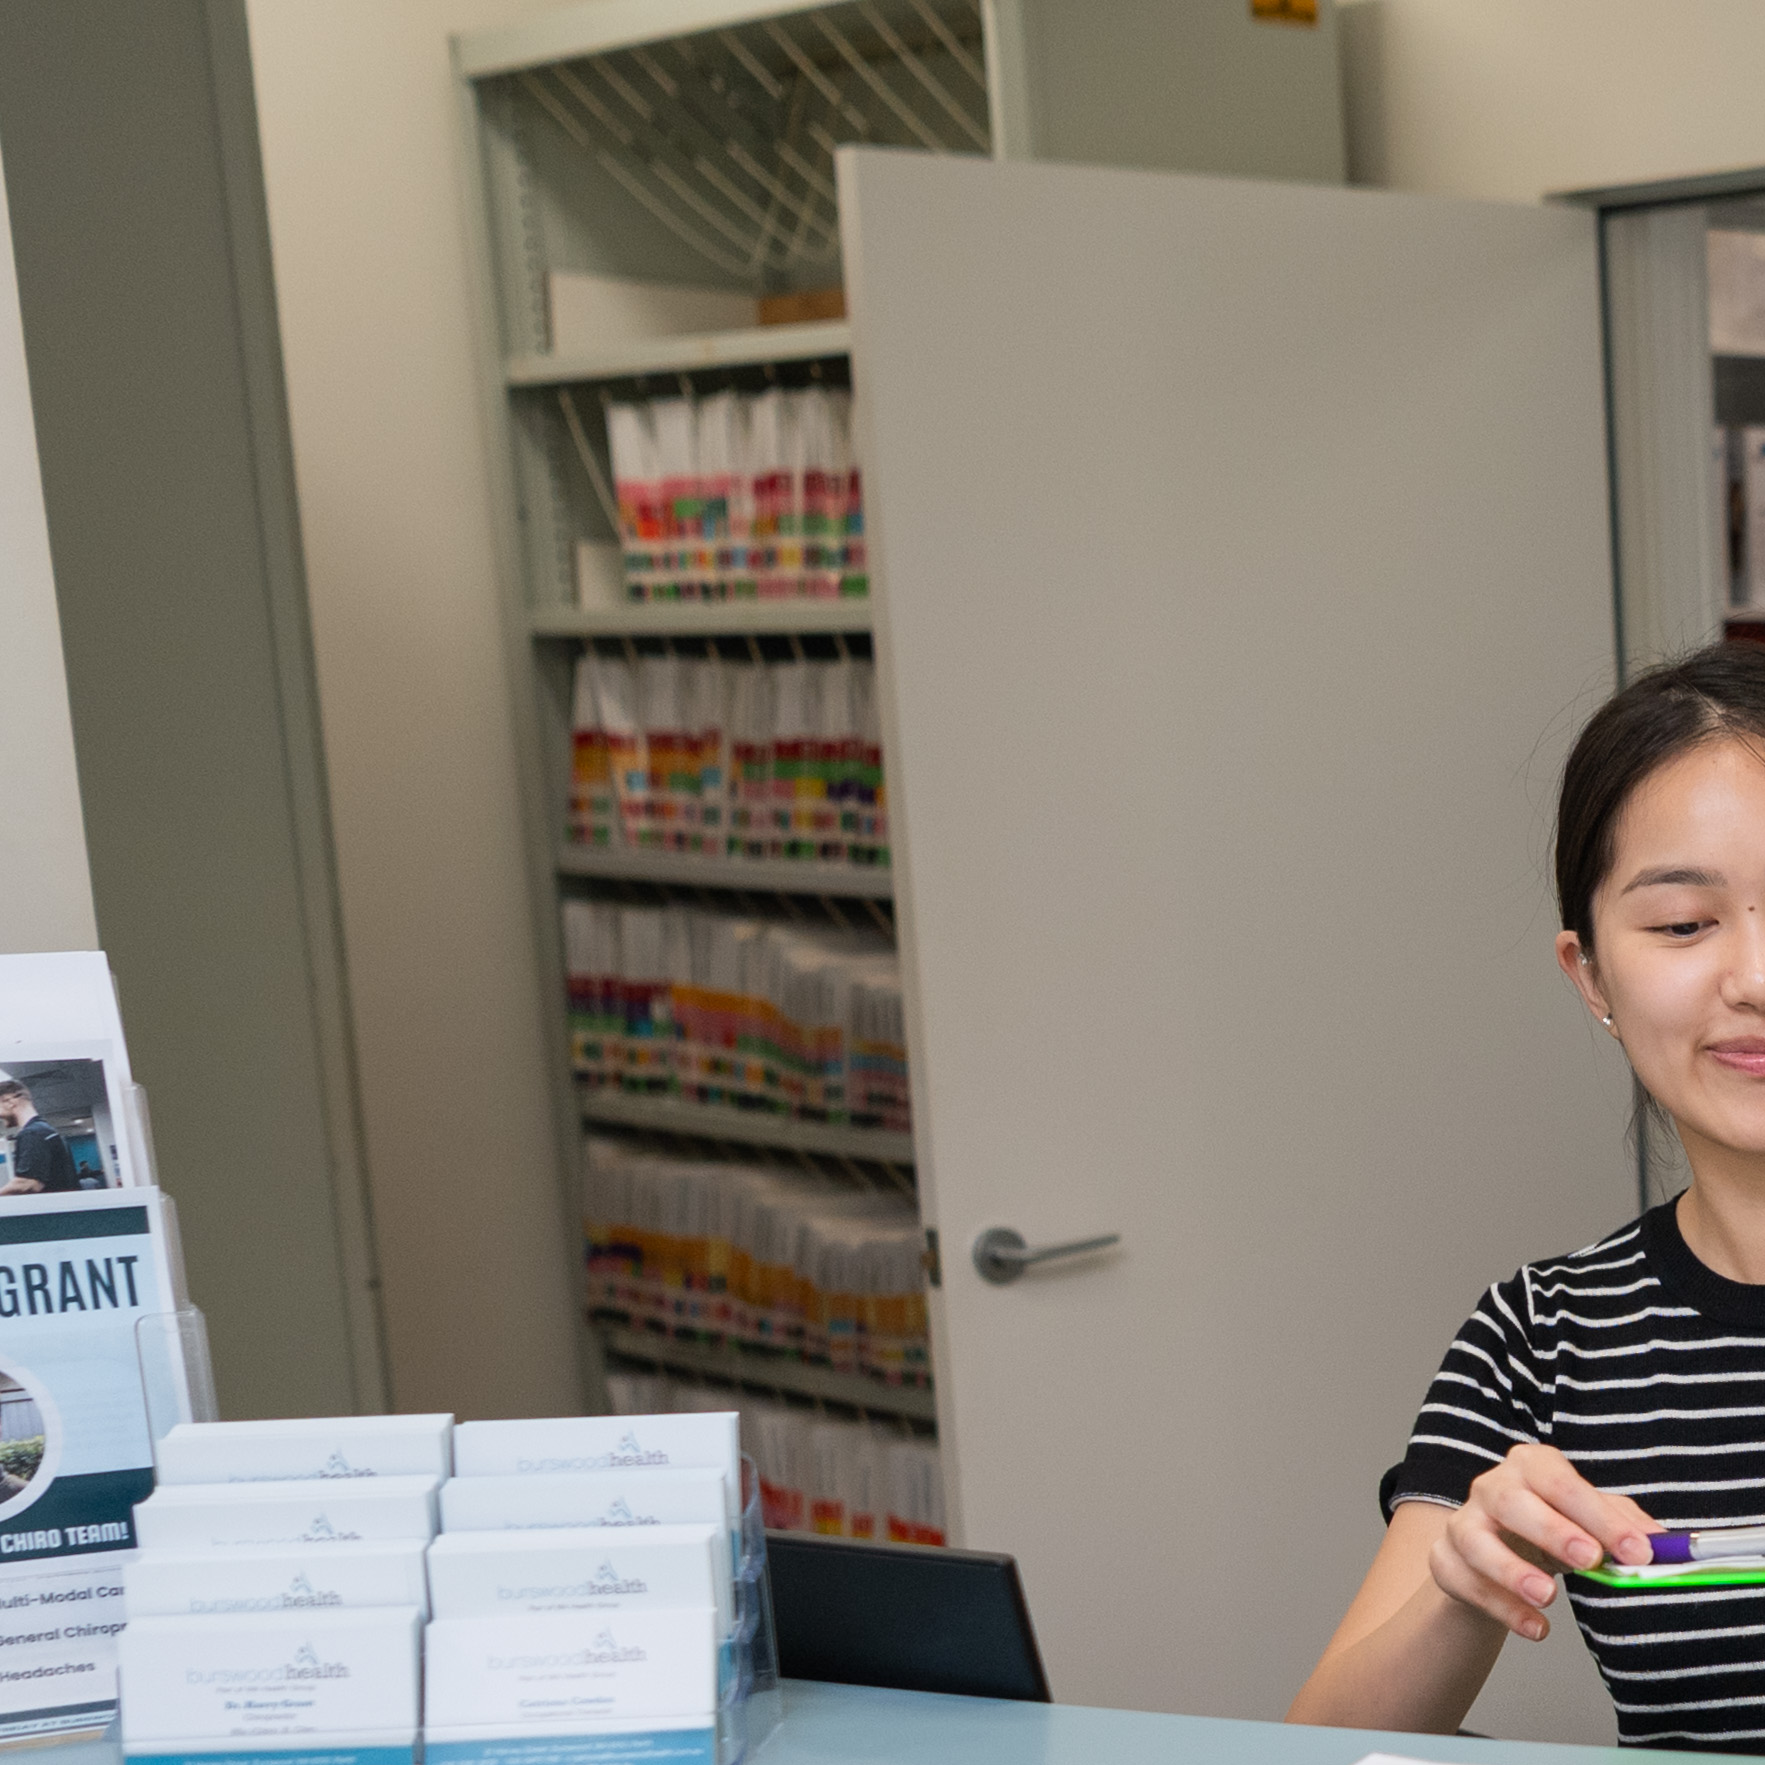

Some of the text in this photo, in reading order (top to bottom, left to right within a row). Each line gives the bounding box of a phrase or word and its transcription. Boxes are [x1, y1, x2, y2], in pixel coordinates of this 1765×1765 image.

[0, 1255, 139, 1318] GRANT
[0, 1522, 129, 1554] CHIRO TEAM!
[0, 1587, 92, 1610] ulti-Modal
[0, 1662, 96, 1682] Headaches
